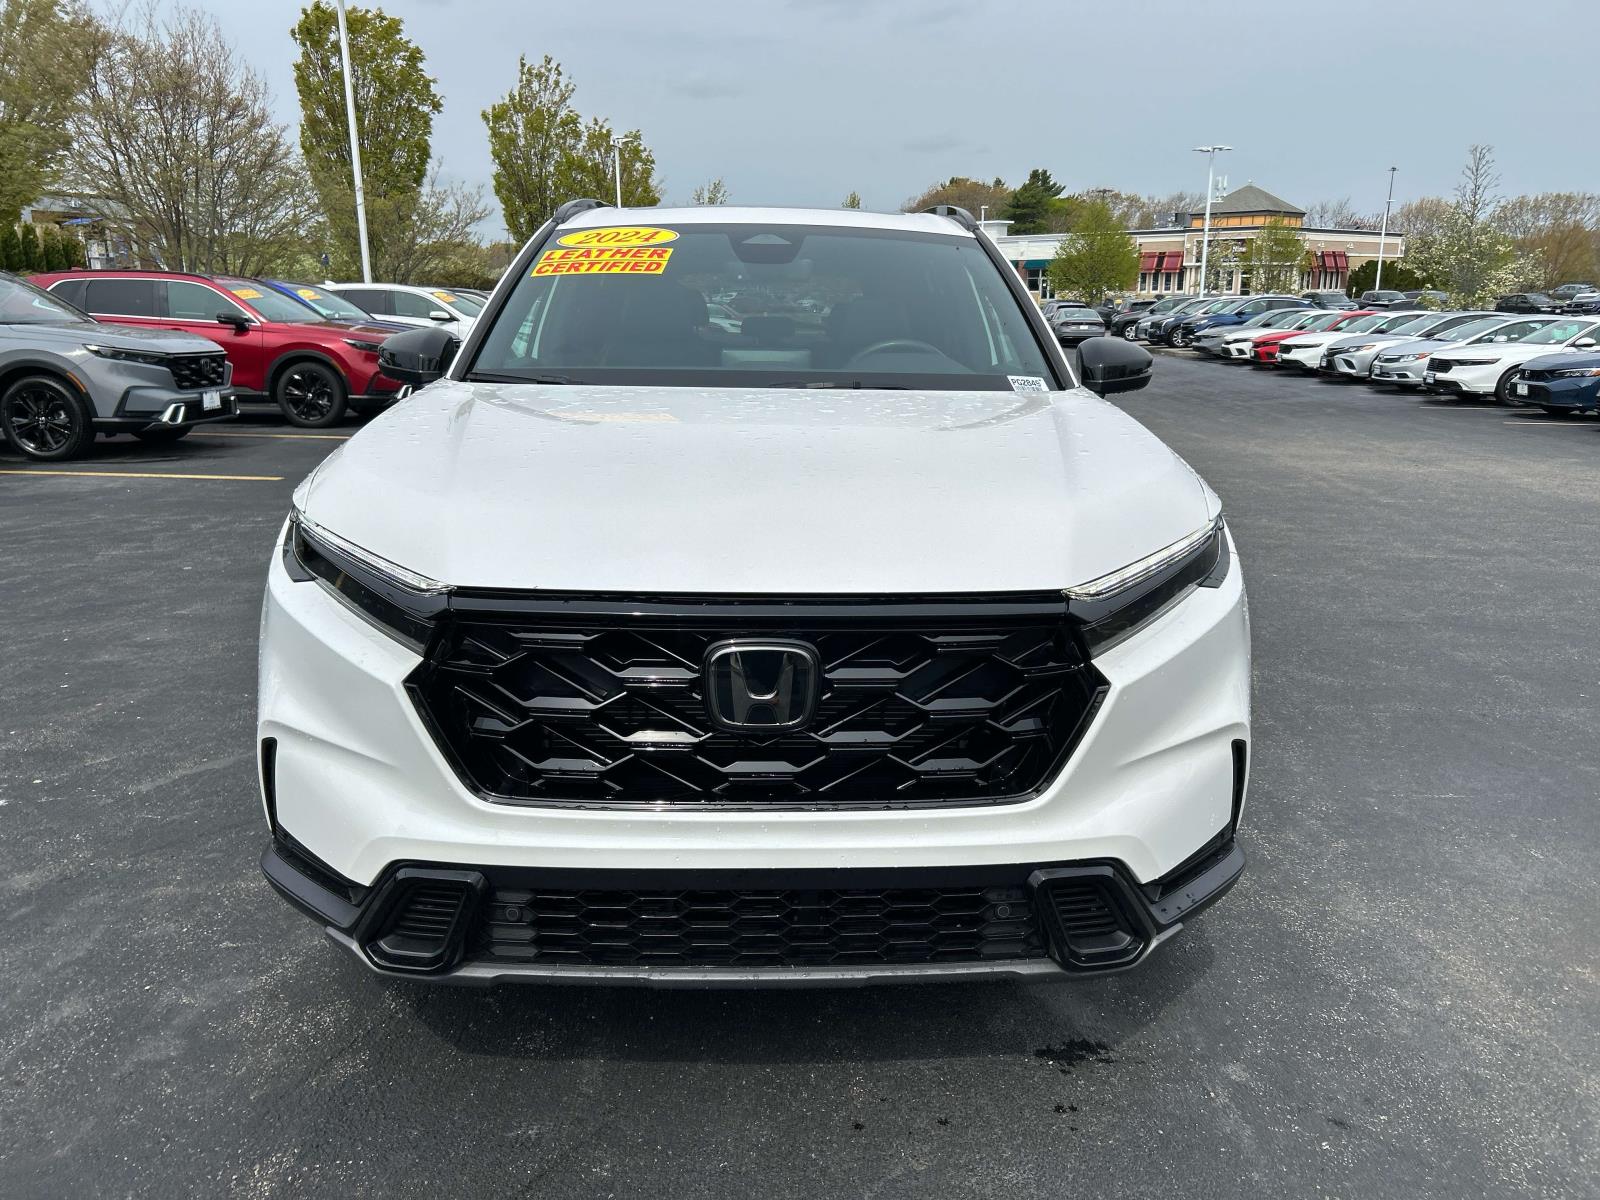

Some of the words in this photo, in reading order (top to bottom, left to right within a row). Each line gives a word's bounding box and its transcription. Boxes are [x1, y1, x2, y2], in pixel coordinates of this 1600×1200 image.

[576, 231, 661, 245] 2024
[543, 248, 669, 261] LEATHER
[535, 261, 662, 274] CERTIFIED
